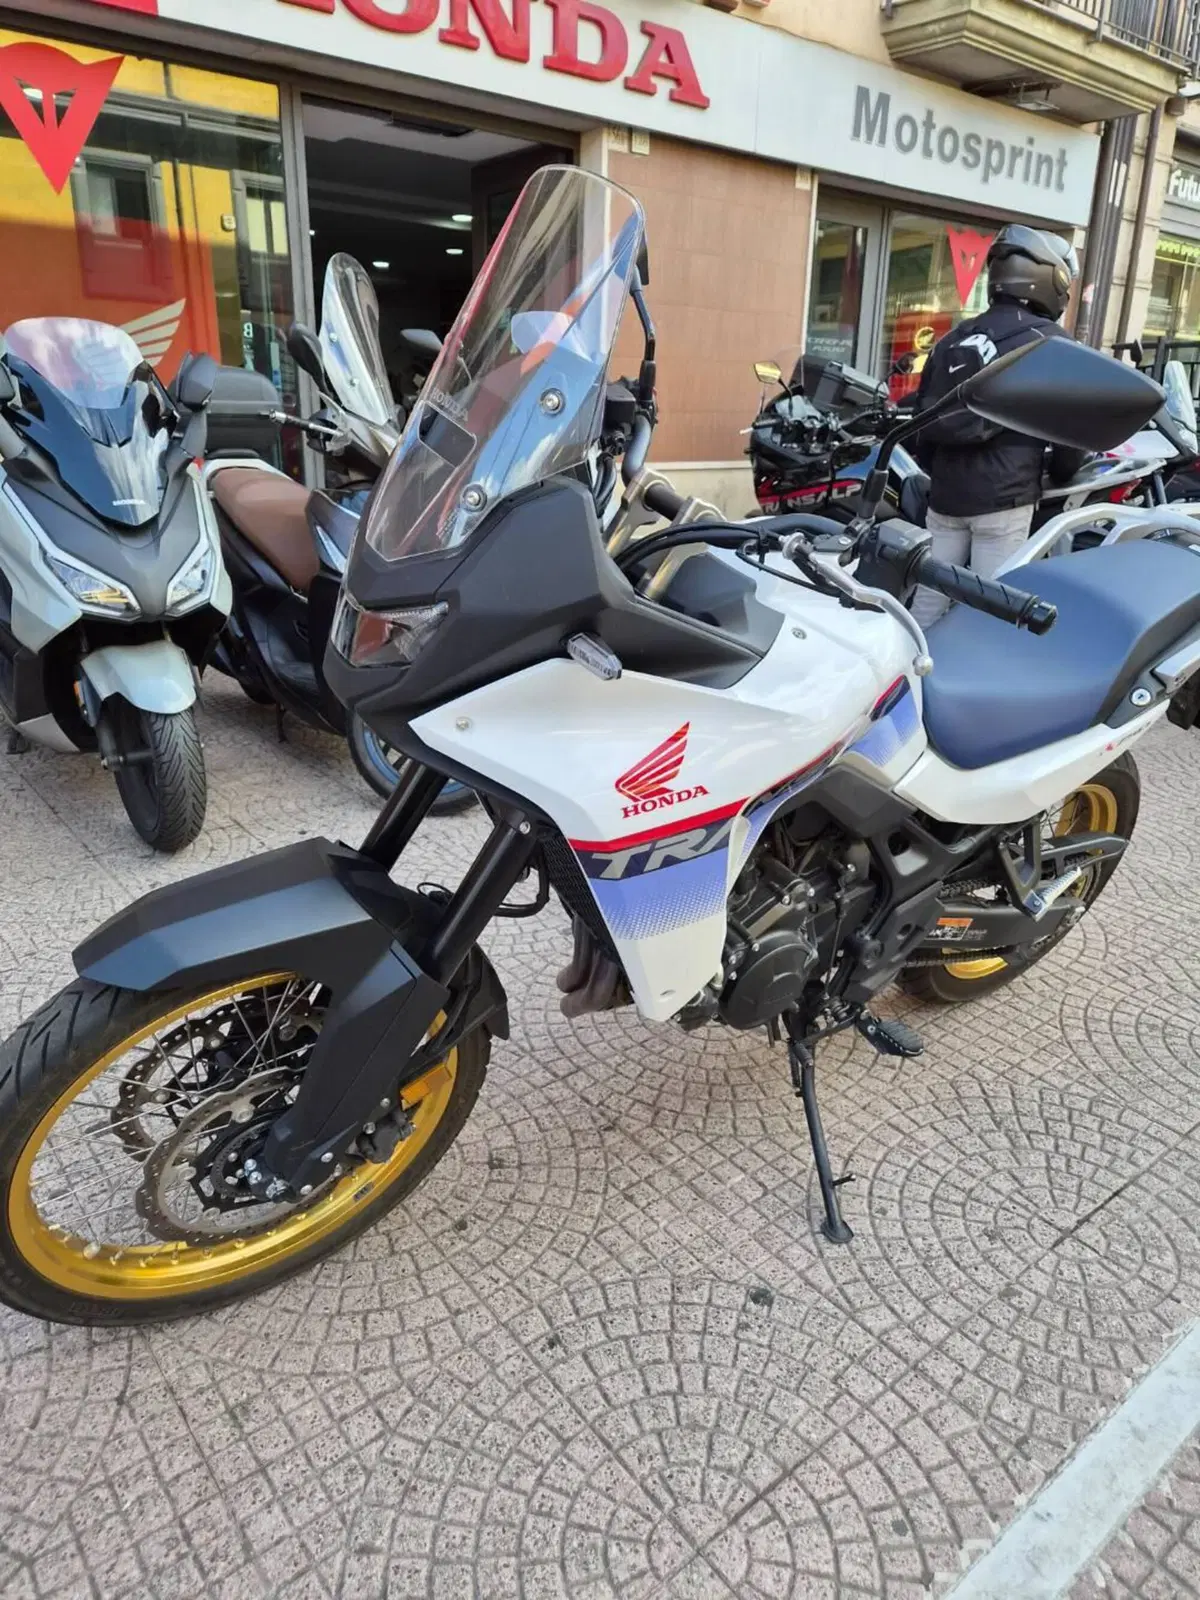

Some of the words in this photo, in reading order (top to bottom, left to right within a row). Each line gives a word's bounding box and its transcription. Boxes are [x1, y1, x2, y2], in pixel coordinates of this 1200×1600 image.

[276, 0, 710, 109] ONDA
[851, 85, 1069, 193] Motosprint
[620, 785, 710, 819] HONDA
